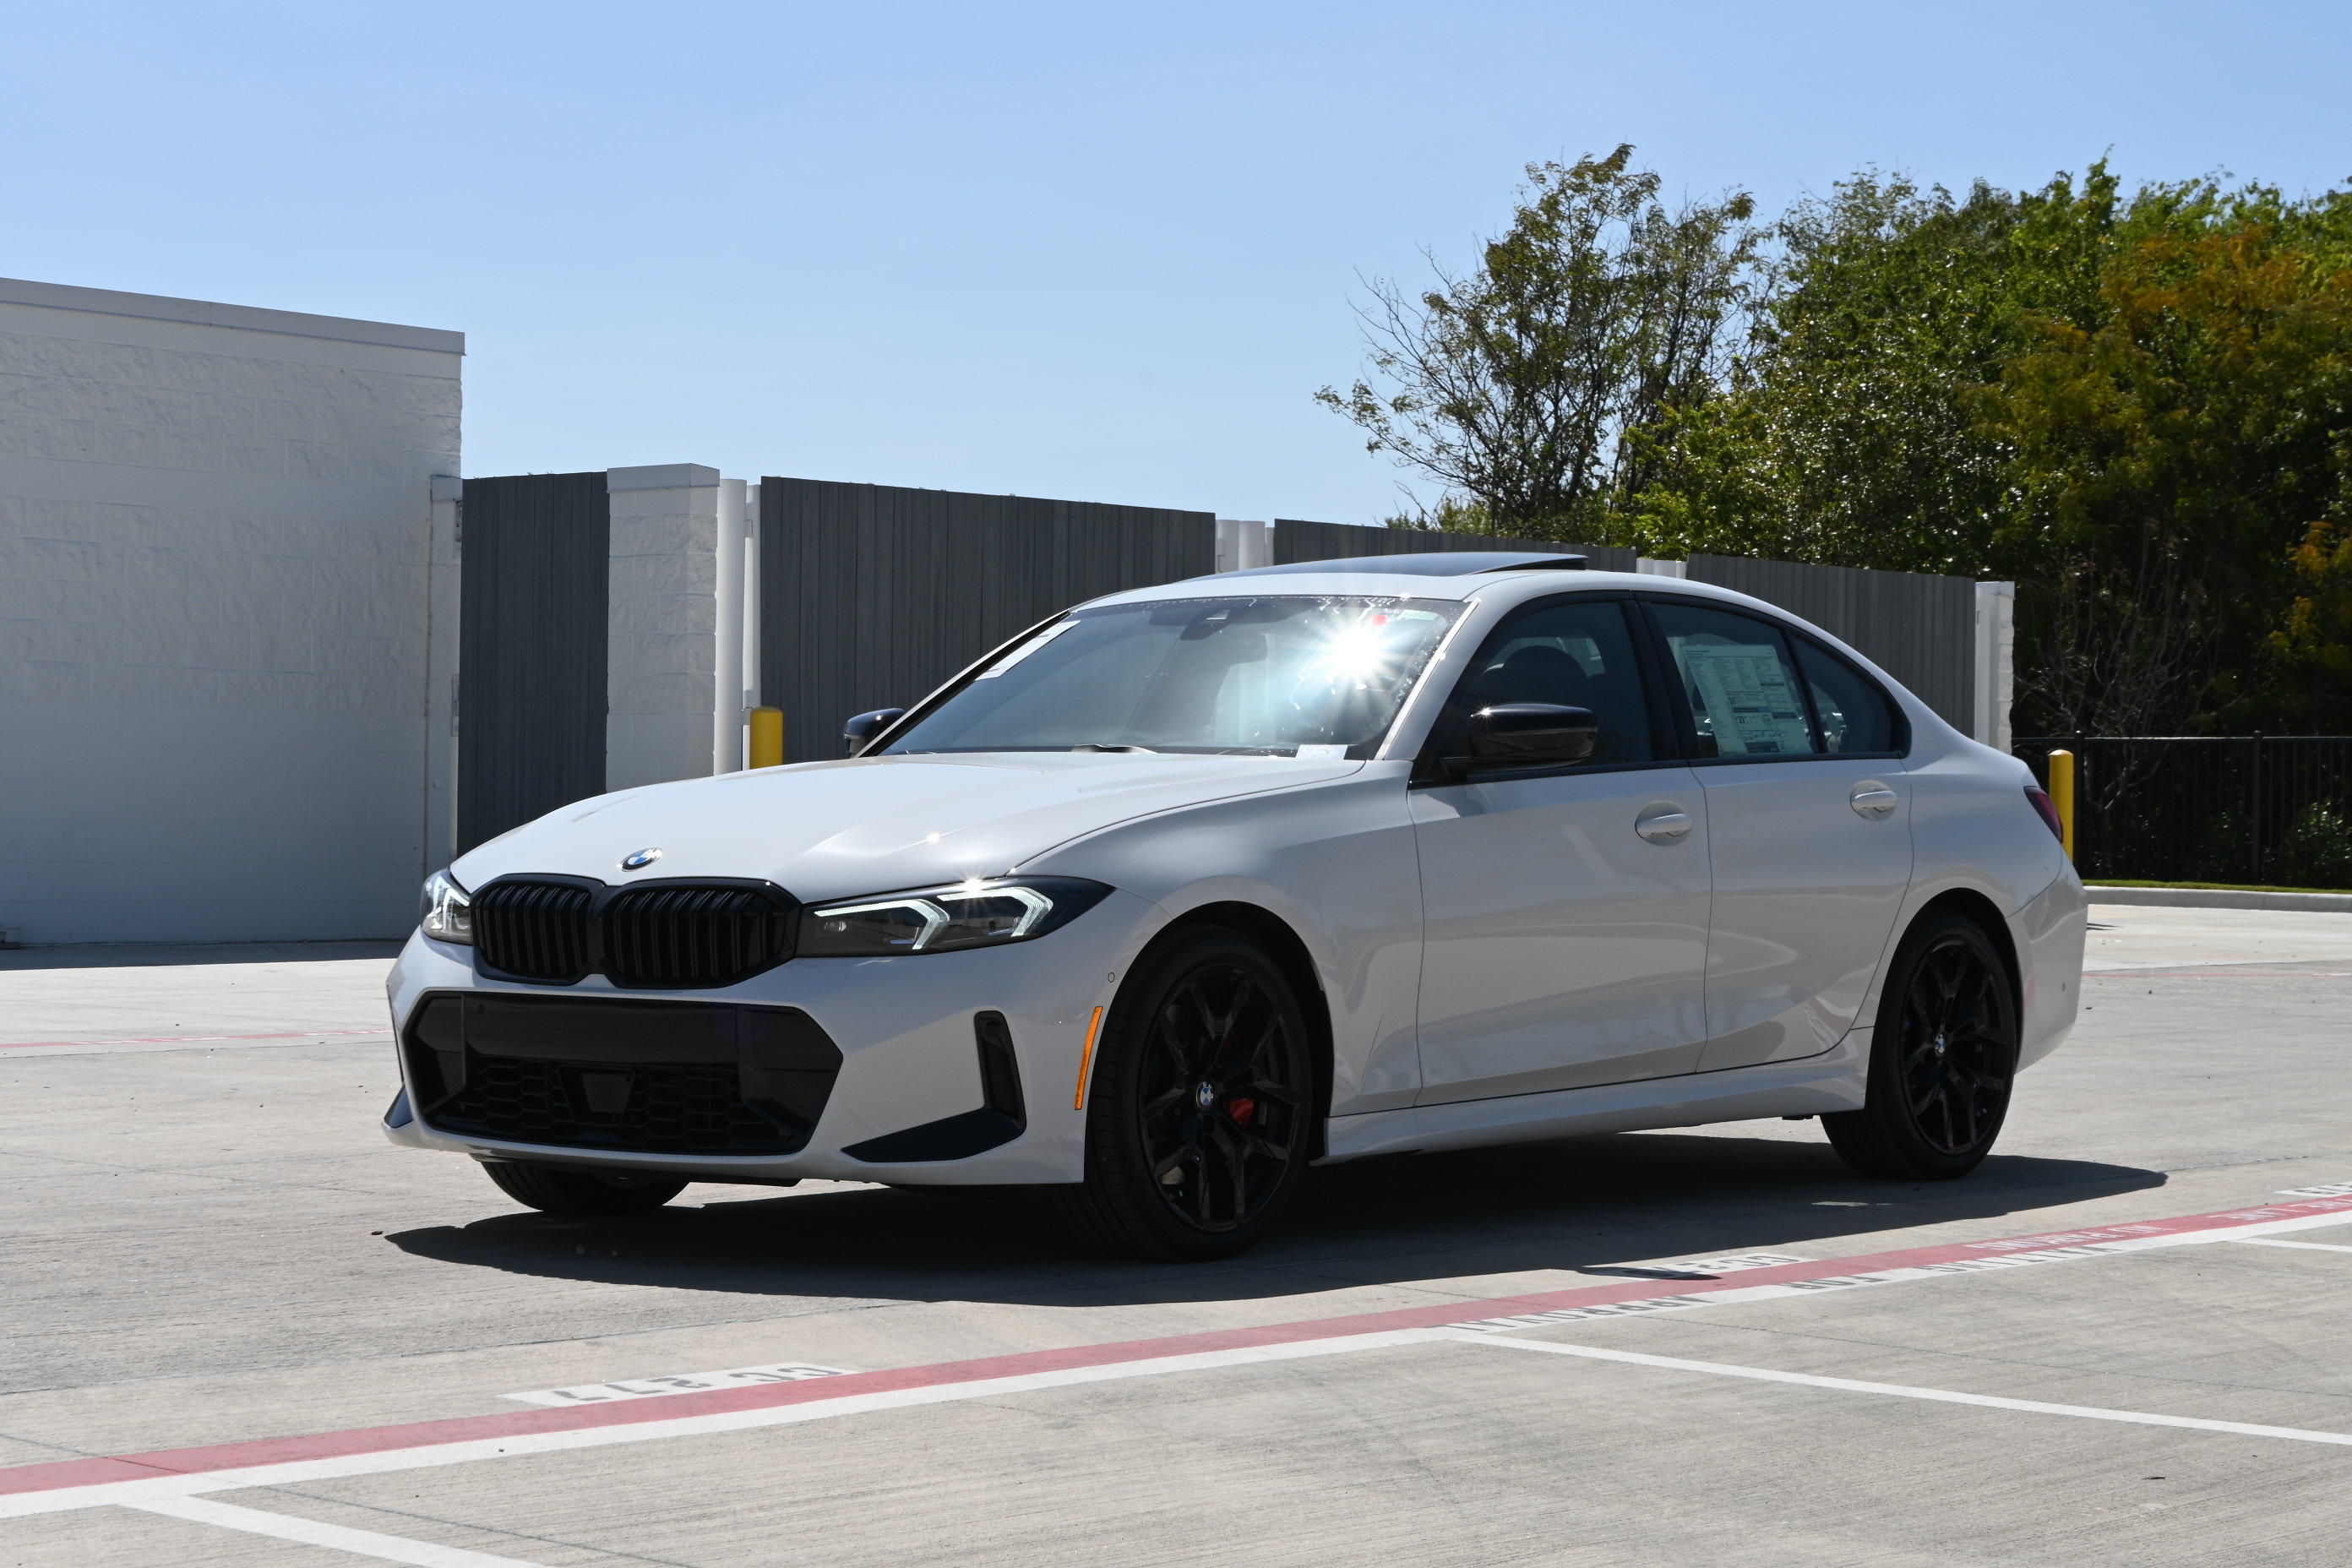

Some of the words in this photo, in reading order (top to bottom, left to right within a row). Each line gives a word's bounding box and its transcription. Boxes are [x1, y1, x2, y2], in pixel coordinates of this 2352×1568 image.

[1963, 1233, 2123, 1251] PARKING
[1912, 1247, 2121, 1273] WAITING
[1779, 1276, 1888, 1290] FOR
[1440, 1295, 1715, 1331] APPROVAL
[729, 1367, 843, 1383] CC
[553, 1376, 713, 1402] 277
